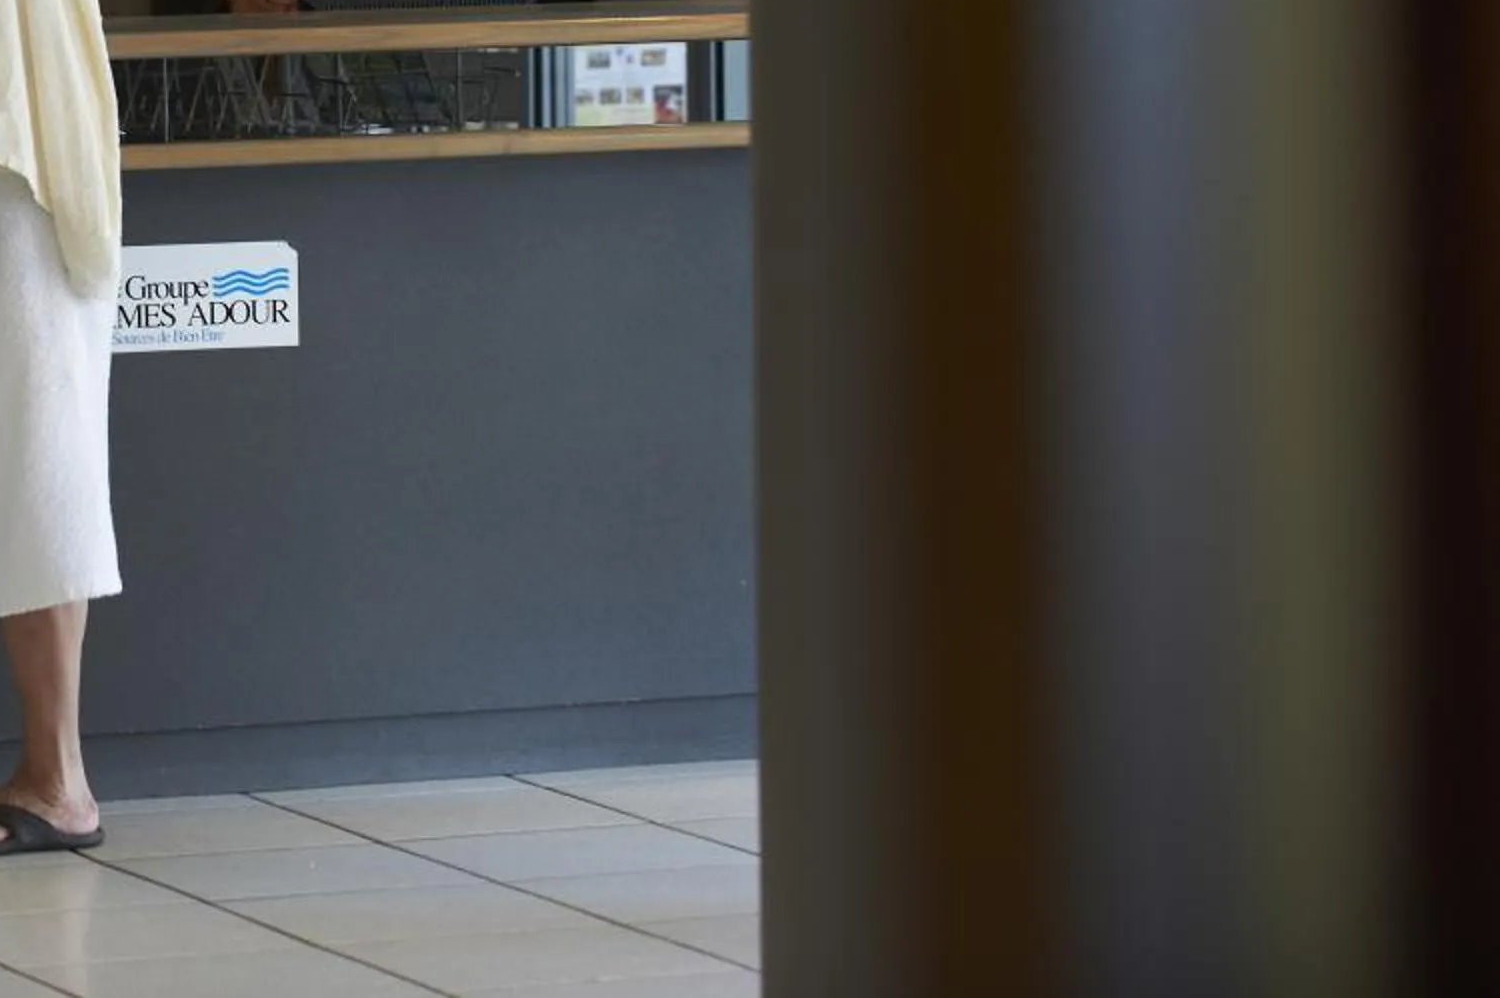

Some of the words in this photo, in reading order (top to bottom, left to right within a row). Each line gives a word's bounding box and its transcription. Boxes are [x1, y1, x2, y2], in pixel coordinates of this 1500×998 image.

[125, 275, 210, 306] Groupe
[113, 303, 177, 329] MES
[187, 299, 291, 326] ADOUR
